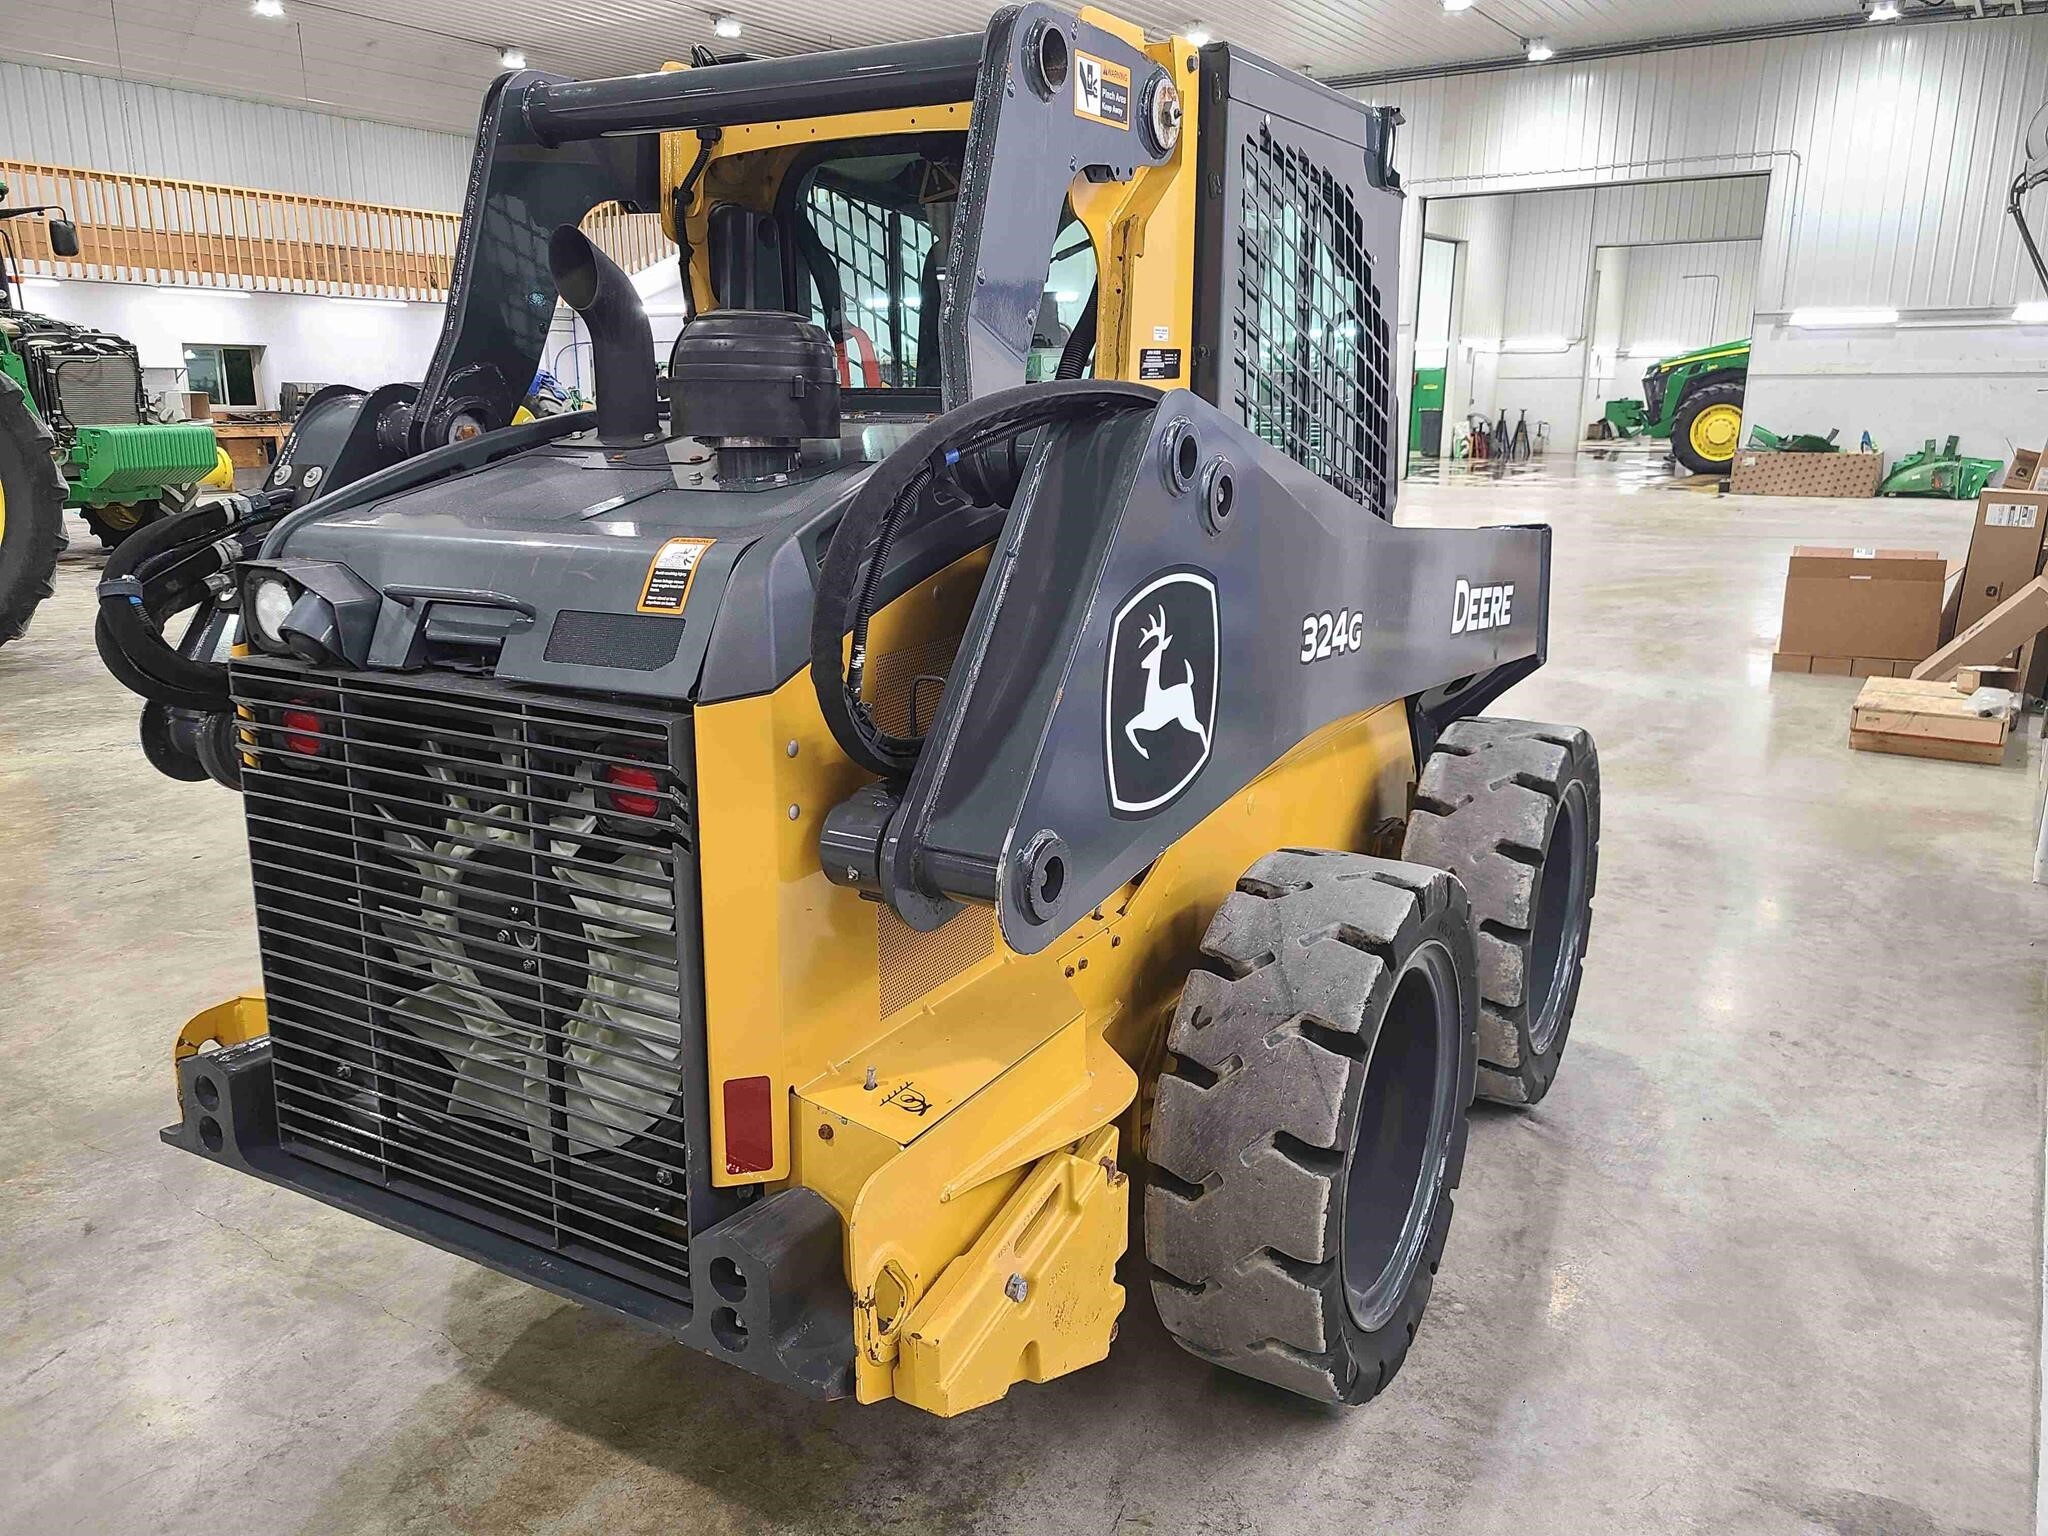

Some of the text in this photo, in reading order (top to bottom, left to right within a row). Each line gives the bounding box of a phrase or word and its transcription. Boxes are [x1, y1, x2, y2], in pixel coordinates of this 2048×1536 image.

[1102, 88, 1127, 104] Pinch Area
[1102, 102, 1112, 113] Keep
[1301, 610, 1363, 663] 324G
